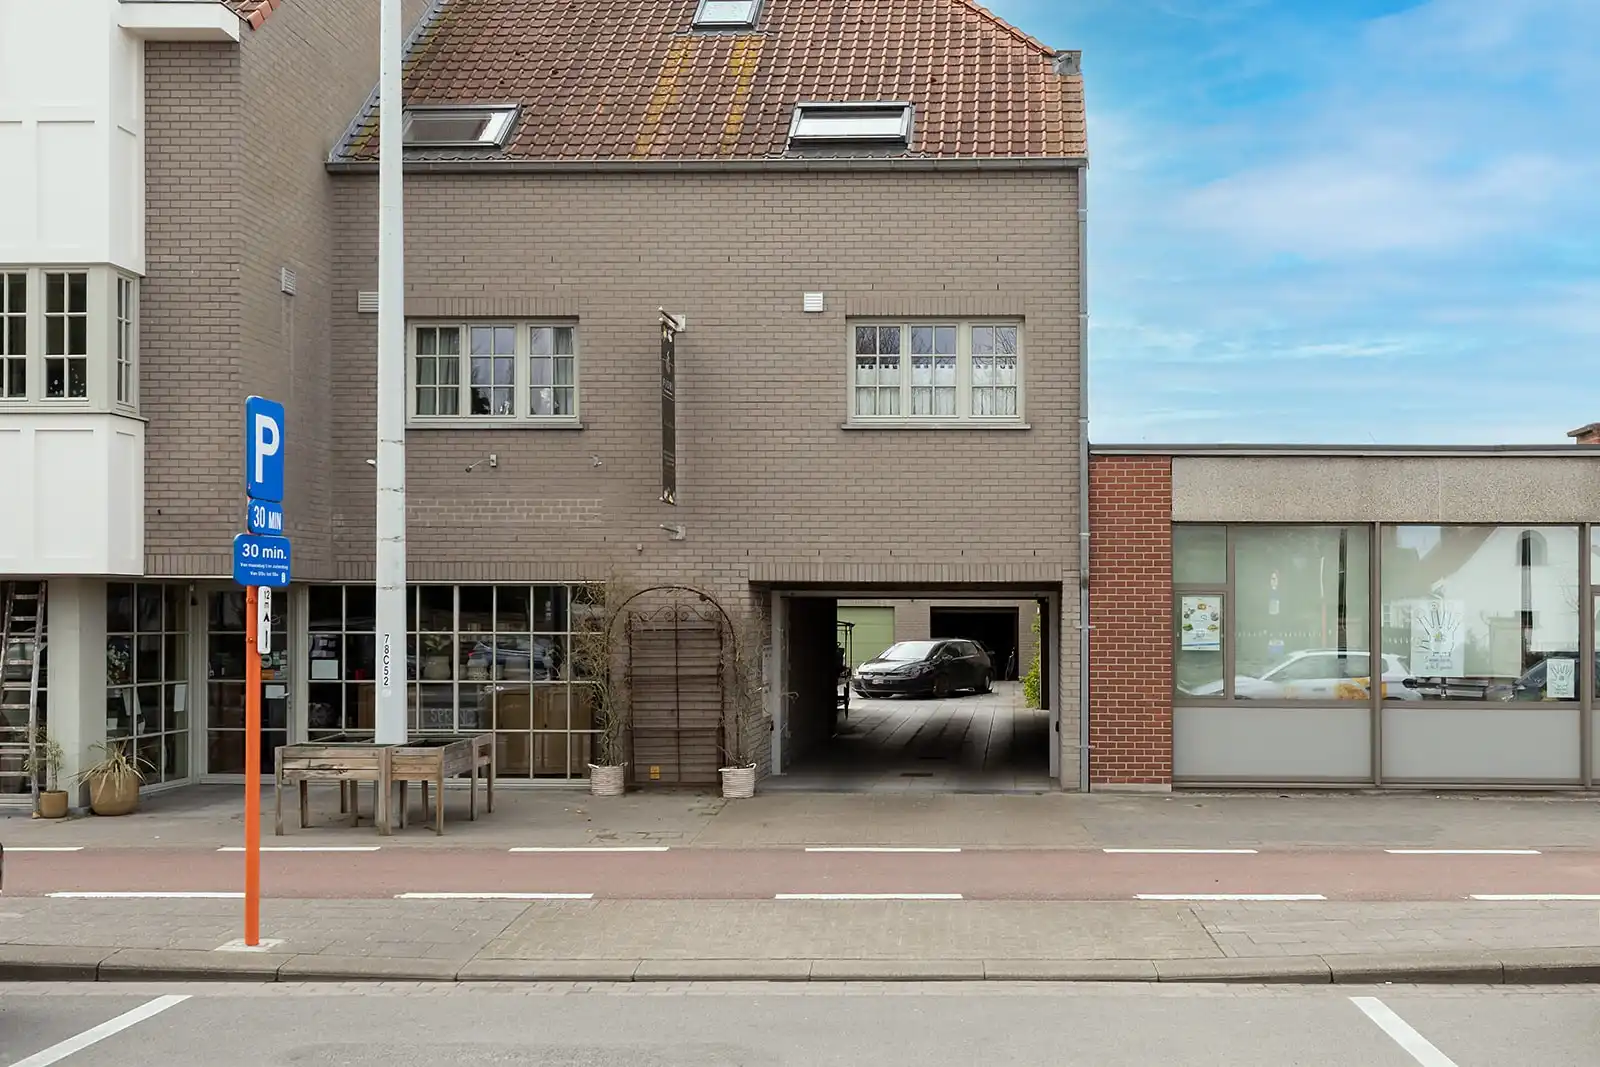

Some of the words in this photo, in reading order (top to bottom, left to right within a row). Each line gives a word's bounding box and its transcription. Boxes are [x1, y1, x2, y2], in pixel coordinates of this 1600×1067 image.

[255, 413, 280, 483] P
[253, 505, 265, 528] 30
[268, 510, 282, 530] MIN
[242, 543, 259, 557] 30
[262, 546, 287, 560] min.
[430, 707, 476, 724] SPRNG
